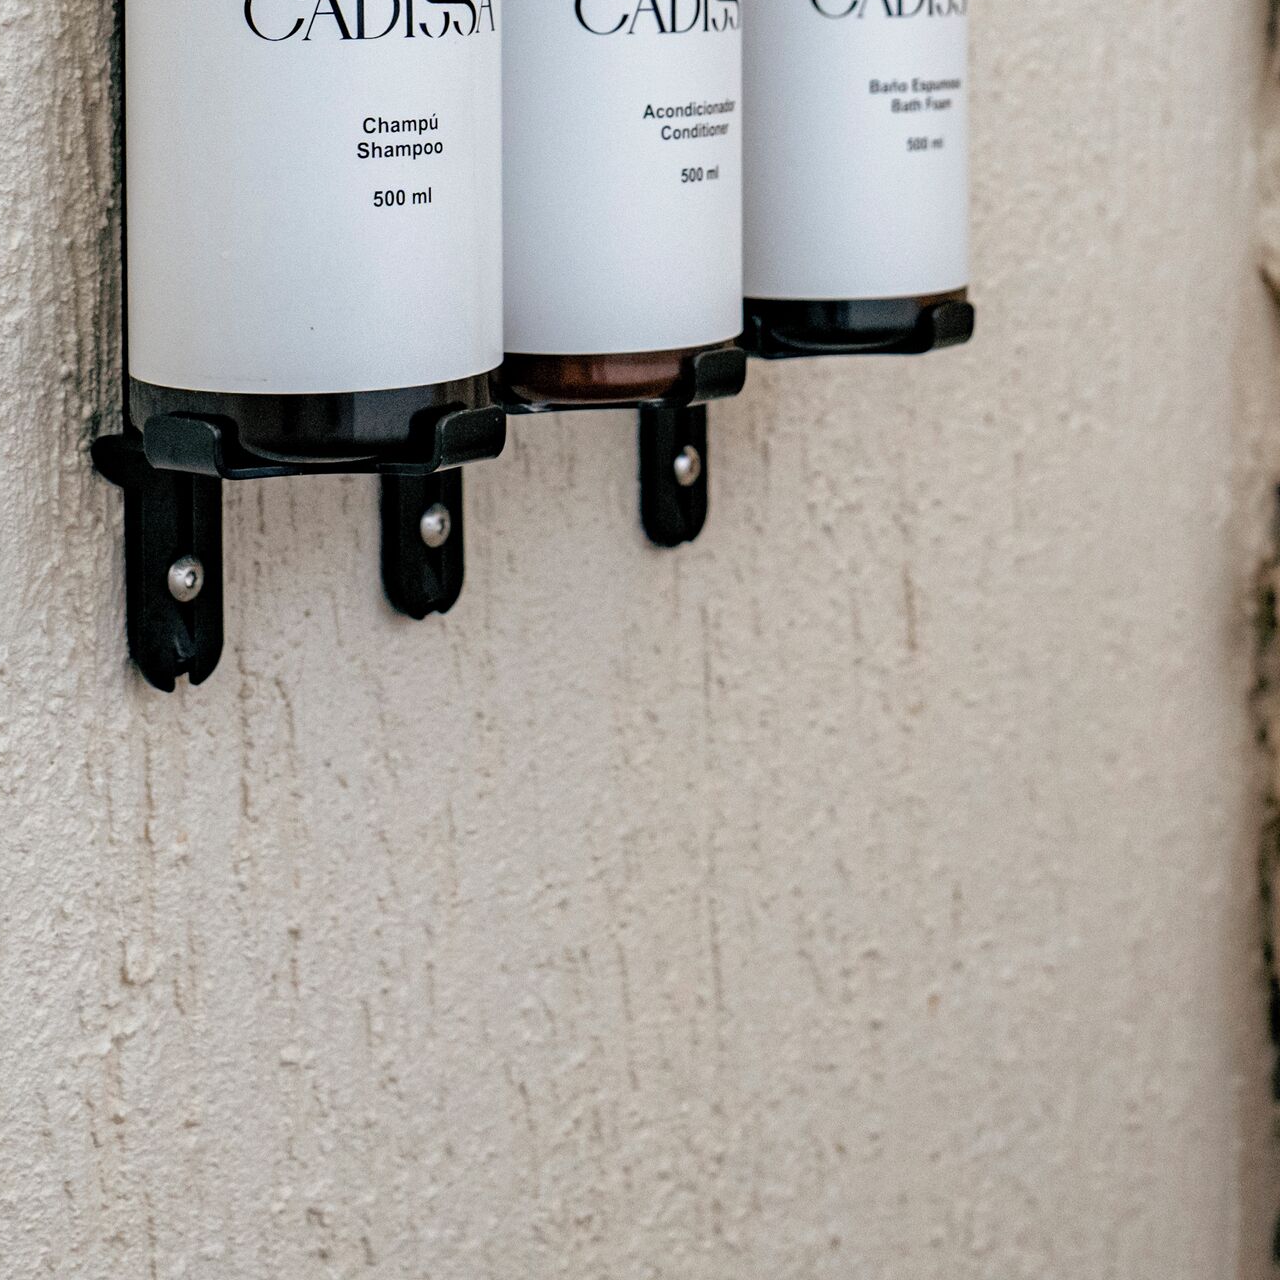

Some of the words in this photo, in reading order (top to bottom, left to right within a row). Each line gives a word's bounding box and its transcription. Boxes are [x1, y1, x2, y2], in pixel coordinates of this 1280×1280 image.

[890, 98, 921, 114] Bath
[362, 112, 439, 136] Champú
[660, 122, 729, 141] Conditioner
[356, 141, 444, 161] Shampoo
[906, 136, 929, 152] 500
[680, 166, 704, 184] 500
[706, 164, 719, 181] ml
[373, 188, 406, 208] 500
[411, 186, 432, 205] ml
